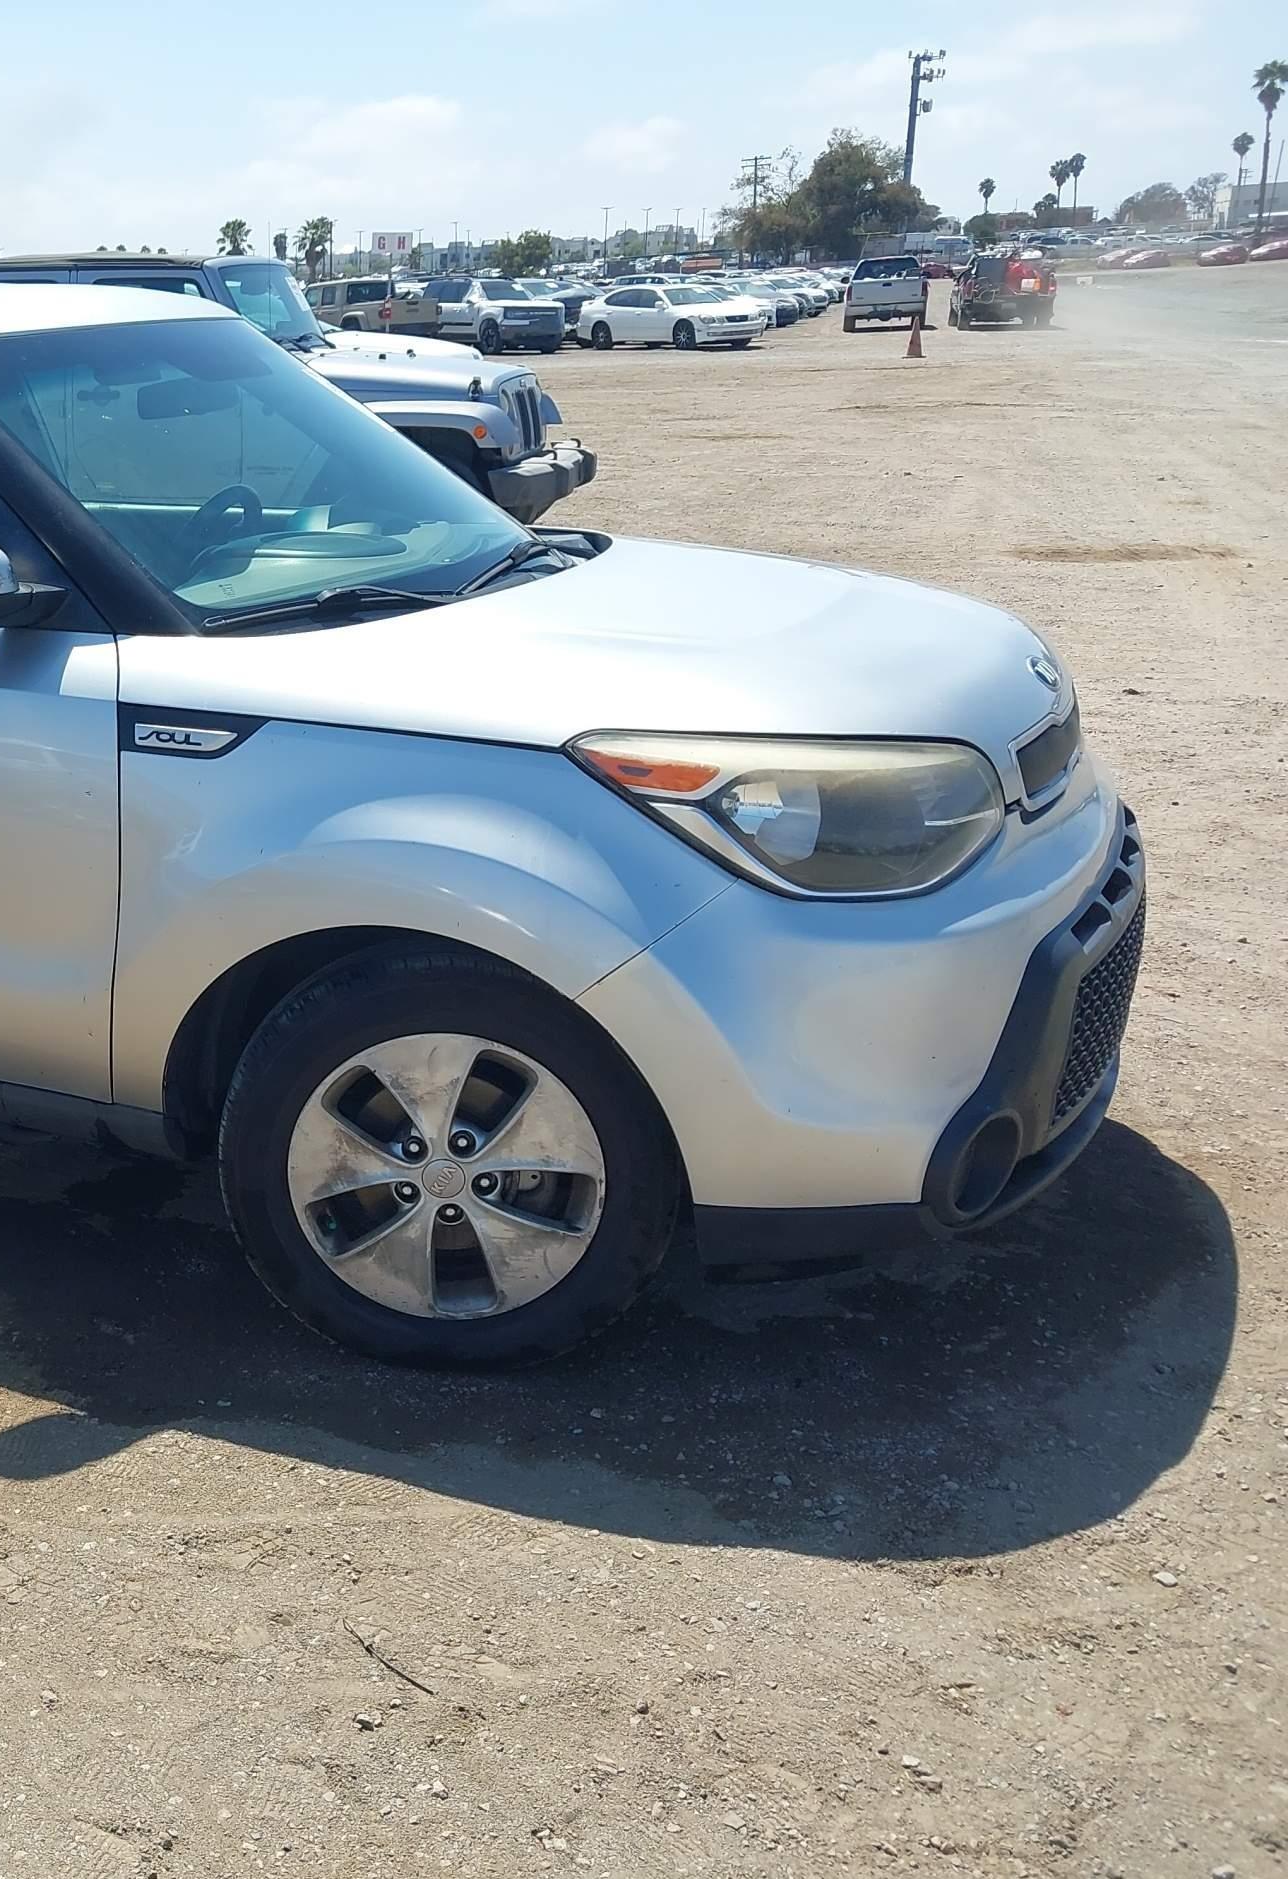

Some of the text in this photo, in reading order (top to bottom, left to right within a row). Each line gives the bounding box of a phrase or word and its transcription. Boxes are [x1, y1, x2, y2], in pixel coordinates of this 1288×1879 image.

[377, 235, 406, 250] G H
[138, 730, 202, 746] SOUL
[430, 1166, 457, 1195] KIA
